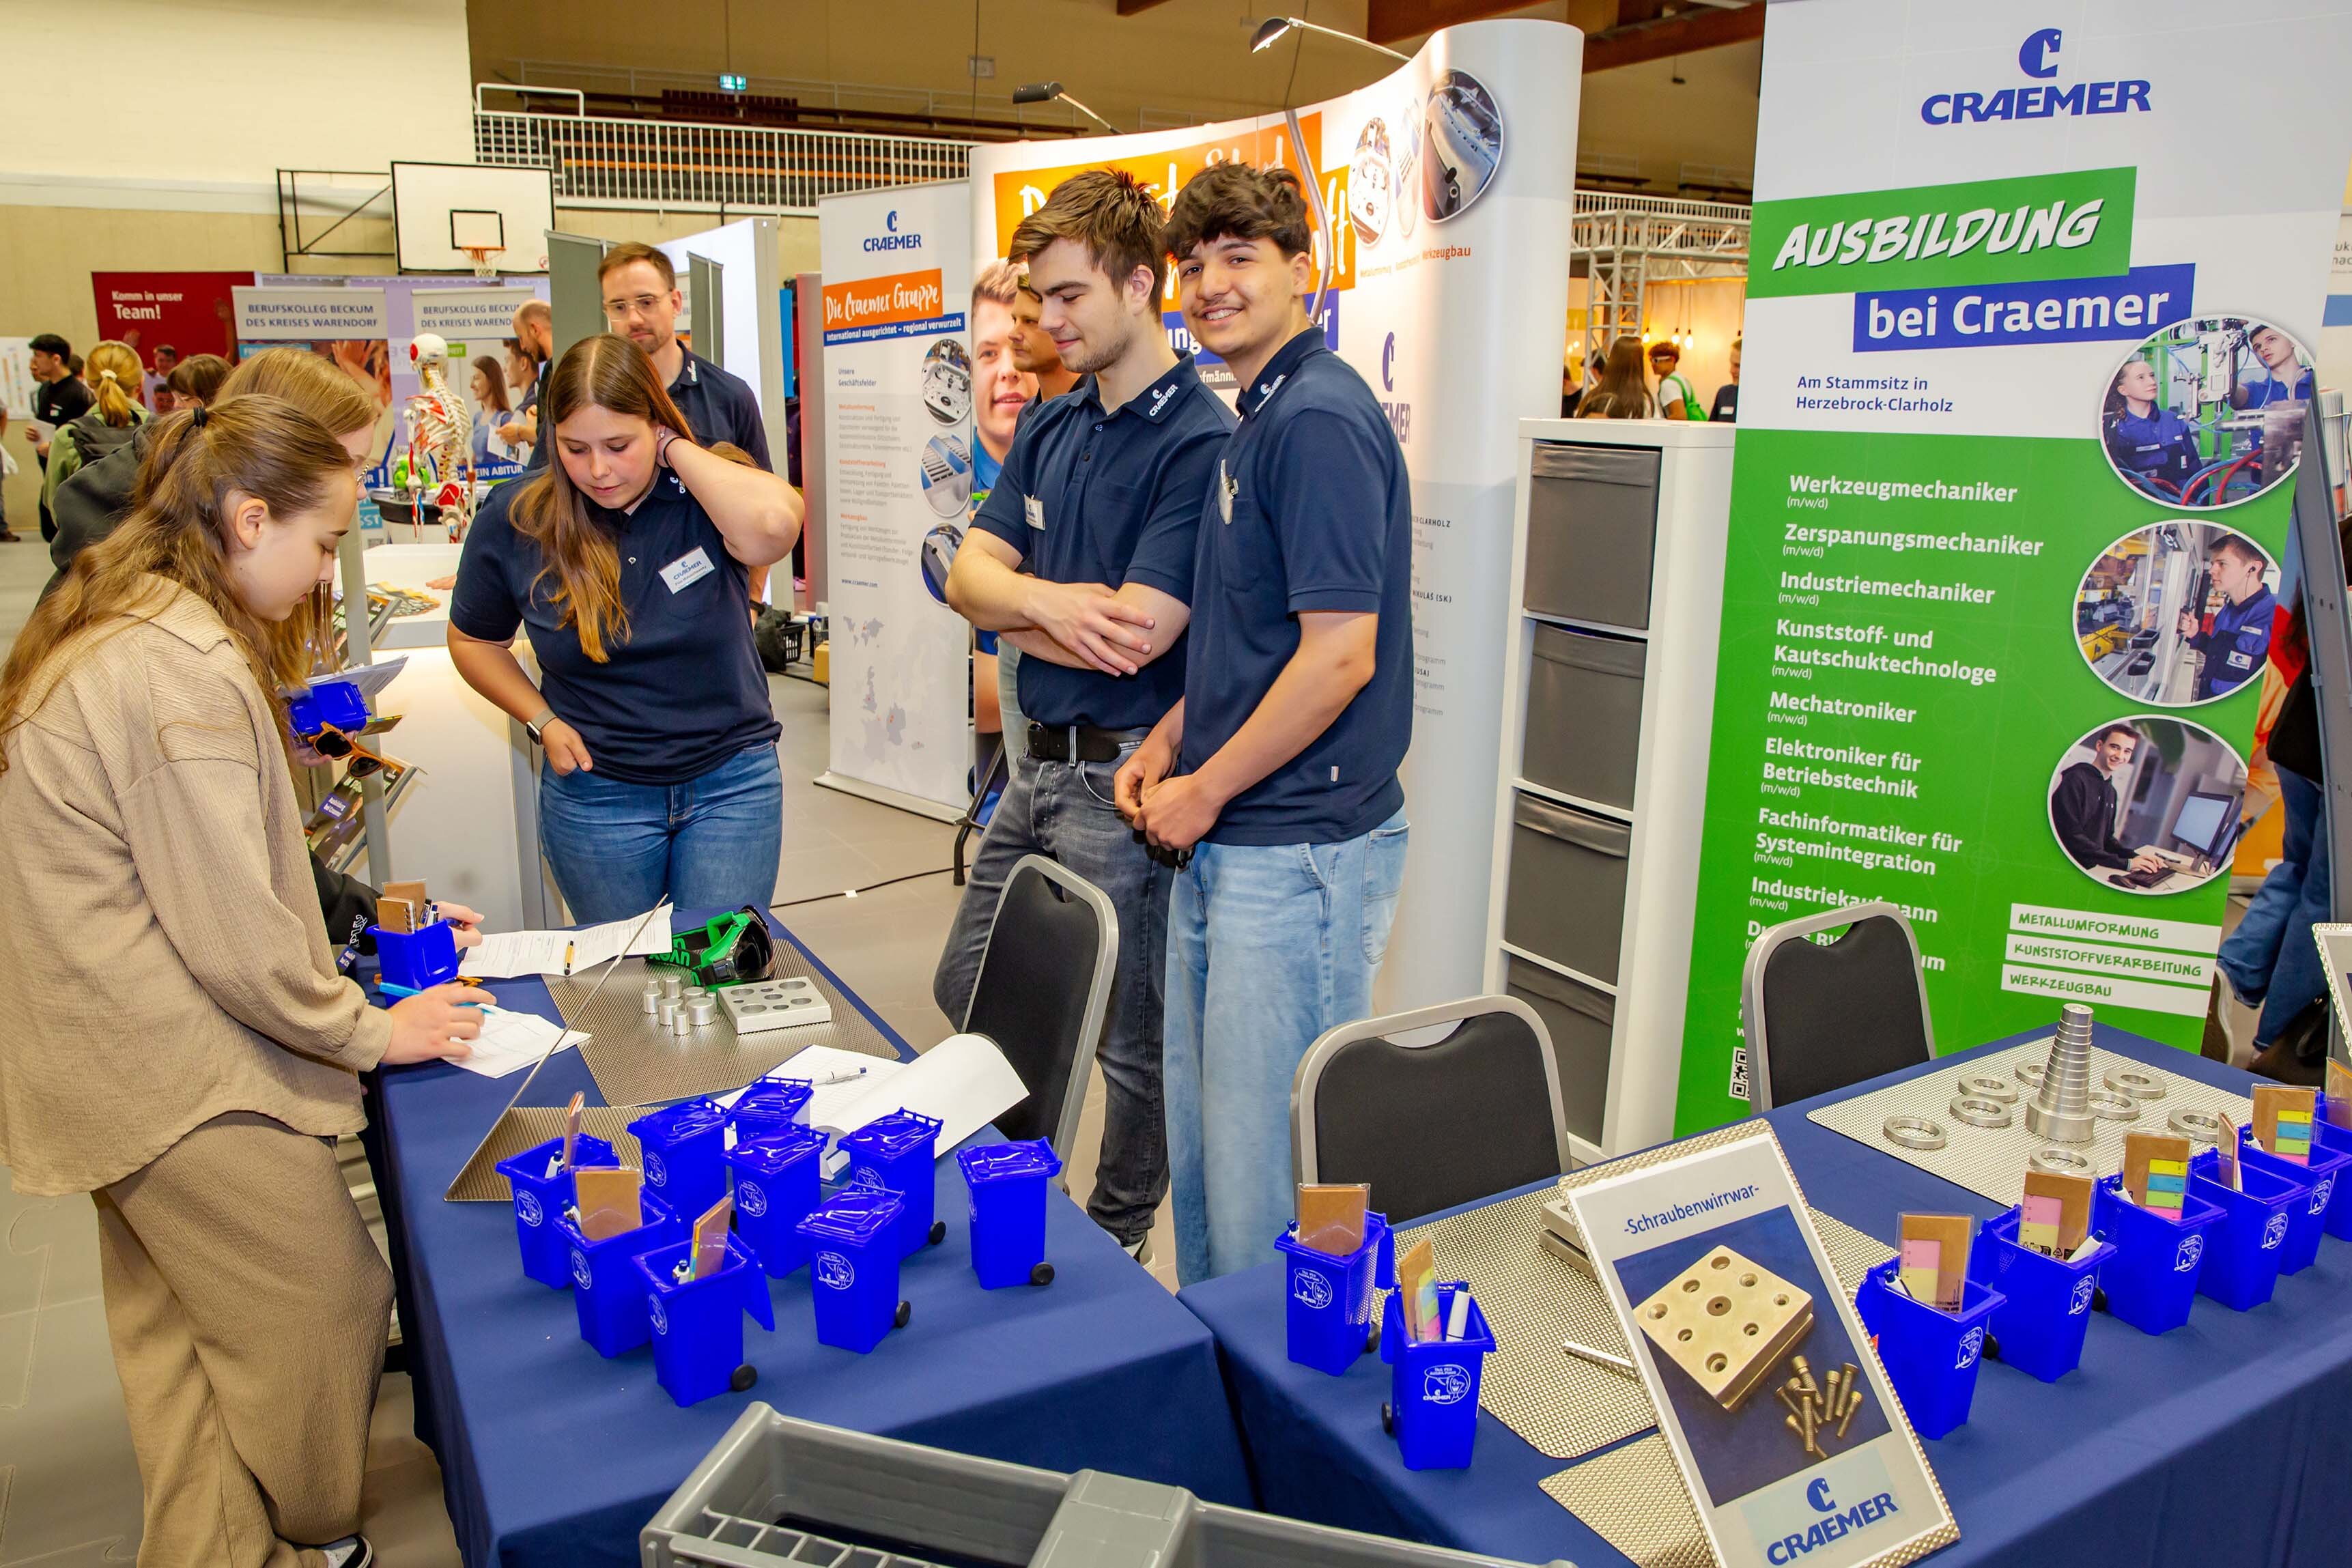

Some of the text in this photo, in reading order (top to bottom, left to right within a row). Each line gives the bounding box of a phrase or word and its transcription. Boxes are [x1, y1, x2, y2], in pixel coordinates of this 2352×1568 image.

[1921, 80, 2151, 125] CRAEMER
[863, 234, 922, 252] CRAEMER
[1772, 199, 2104, 271] AUSBILDUNG
[112, 291, 183, 302] Komm in unser
[249, 304, 373, 314] BERUFSKOLLEG BECKUM
[423, 304, 520, 314] BERUFSKOLLEG BECKU
[825, 283, 939, 325] Die Craemer Gruppe
[113, 304, 160, 319] Team!
[246, 319, 378, 327] DES KREISES WARENDORF
[421, 317, 512, 328] DES KREISES WAREND
[1868, 291, 2170, 339] bei Craemer
[826, 329, 861, 341] International
[862, 326, 897, 339] ausgerichtet
[903, 321, 927, 334] regional
[928, 317, 962, 330] verwurzelt
[1798, 375, 1928, 390] Am Stammsitz in
[1149, 384, 1178, 416] CRAEMER
[1796, 396, 1954, 412] Herzebrock-Clarholz
[492, 465, 524, 476] ABITUR
[1789, 475, 2018, 502] Werkzeugmechaniker
[1786, 496, 1828, 510] (m/w/d)
[1782, 544, 1824, 559] (m/w/d)
[1784, 523, 2043, 556] Zerspanungsmechaniker
[1778, 592, 1819, 606] (m/w/d)
[1780, 571, 1996, 604] Industriemechaniker
[1776, 619, 1933, 649] Kunststoff- und
[1772, 665, 1812, 681] (m/w/d)
[1774, 644, 1997, 686] Kautschuktechnologe
[1767, 711, 1808, 726] (m/w/d)
[1769, 692, 1917, 723] Mechatroniker
[1766, 737, 1922, 772] Elektroniker für
[1760, 782, 1800, 797] (m/w/d)
[1763, 762, 1918, 799] Betriebstechnik
[1759, 808, 1963, 853] Fachinformatiker für
[1753, 852, 1793, 868] (m/w/d)
[1755, 833, 1936, 875] Systemintegration
[1749, 896, 1788, 912] (m/w/d)
[1752, 876, 1938, 923] Industriekaann
[2019, 913, 2159, 939] METALLUMFORMUNG
[2014, 943, 2201, 977] KUNSTSTOFFVERARBEITUNG
[2010, 974, 2112, 997] WERKZEUGBAU
[1624, 1184, 1759, 1234] -Schraubenwirrwar-
[1767, 1492, 1899, 1566] CRAEMER
